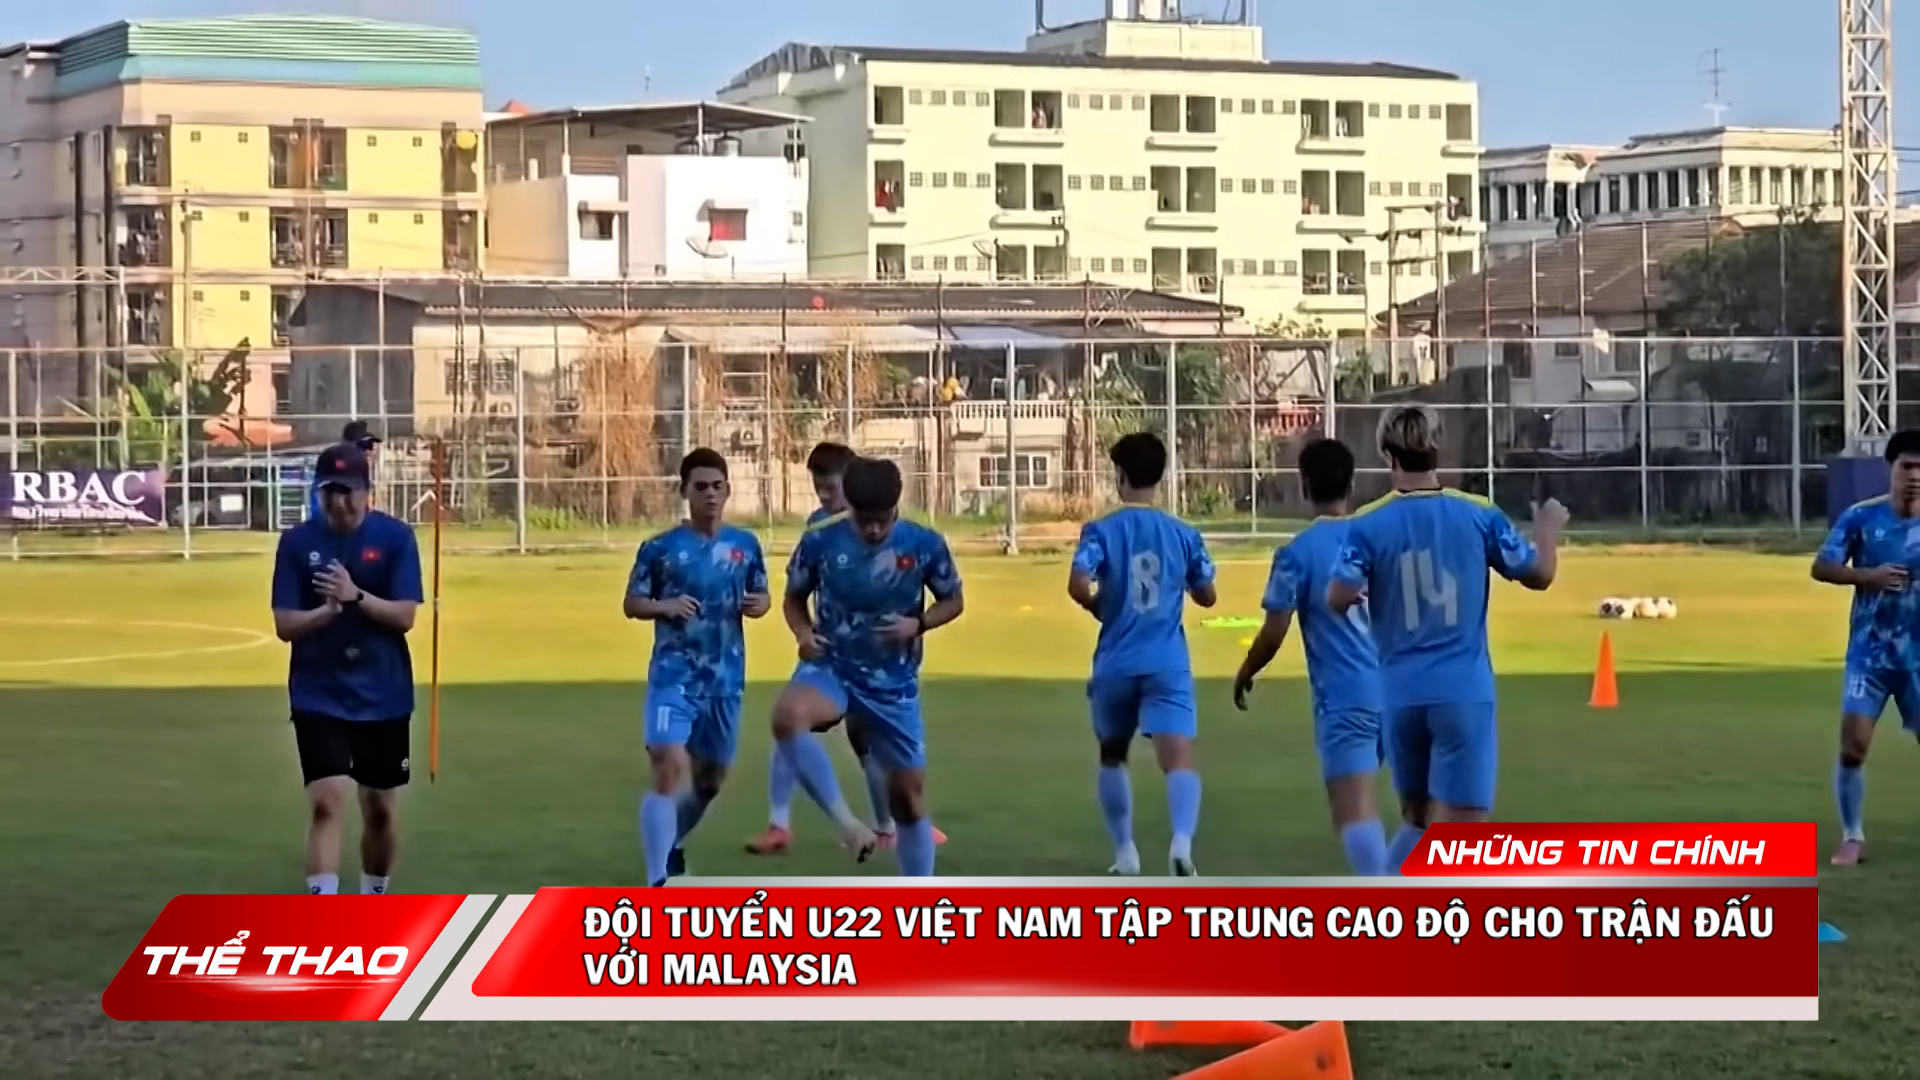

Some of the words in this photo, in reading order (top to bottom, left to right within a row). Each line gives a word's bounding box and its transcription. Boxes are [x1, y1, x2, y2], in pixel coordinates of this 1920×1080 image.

[11, 471, 146, 506] RBAC
[1132, 550, 1160, 614] 8
[1401, 549, 1457, 631] 14
